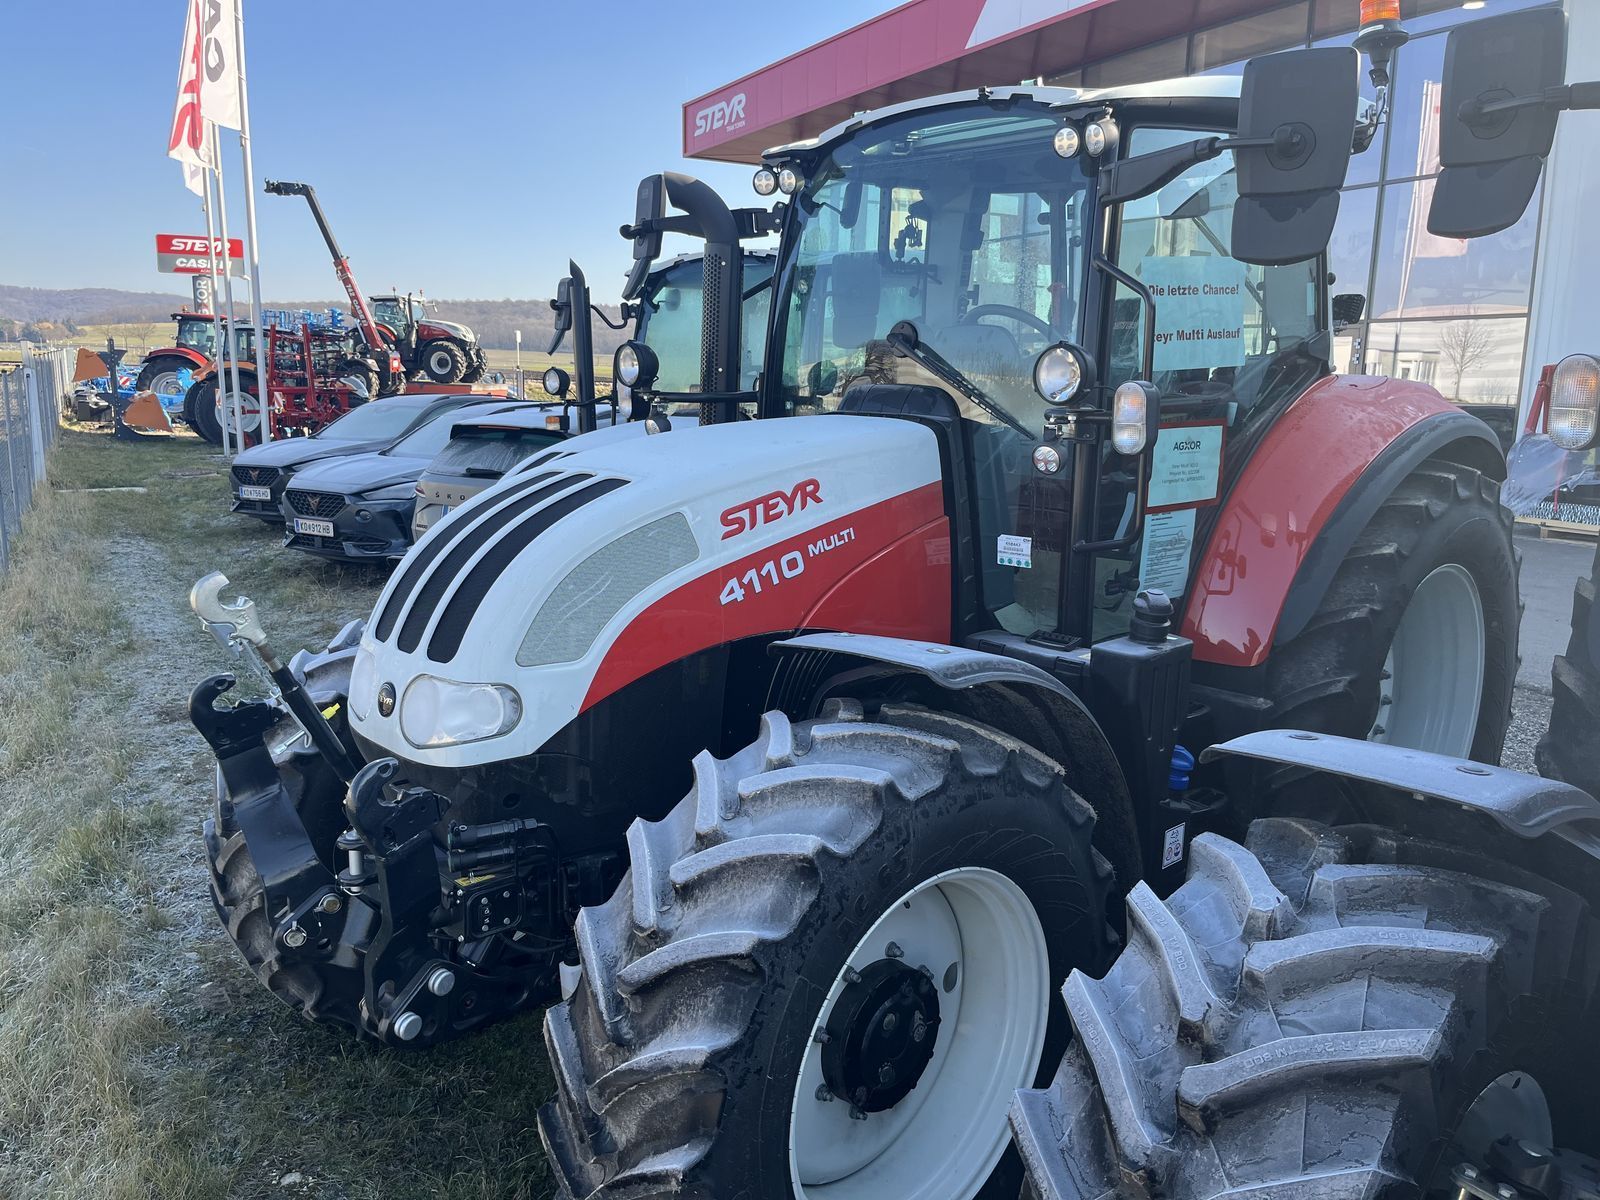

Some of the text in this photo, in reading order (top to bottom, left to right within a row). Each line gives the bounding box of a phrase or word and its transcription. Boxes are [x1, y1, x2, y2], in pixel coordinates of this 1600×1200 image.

[694, 93, 746, 137] STEYR
[1148, 284, 1239, 297] Die letzte Chance!
[1176, 329, 1204, 341] Multi
[1207, 328, 1241, 340] Auslauf
[1173, 441, 1201, 451] AGXOR
[719, 478, 824, 541] STEYR
[719, 527, 856, 606] 4110 MULTI
